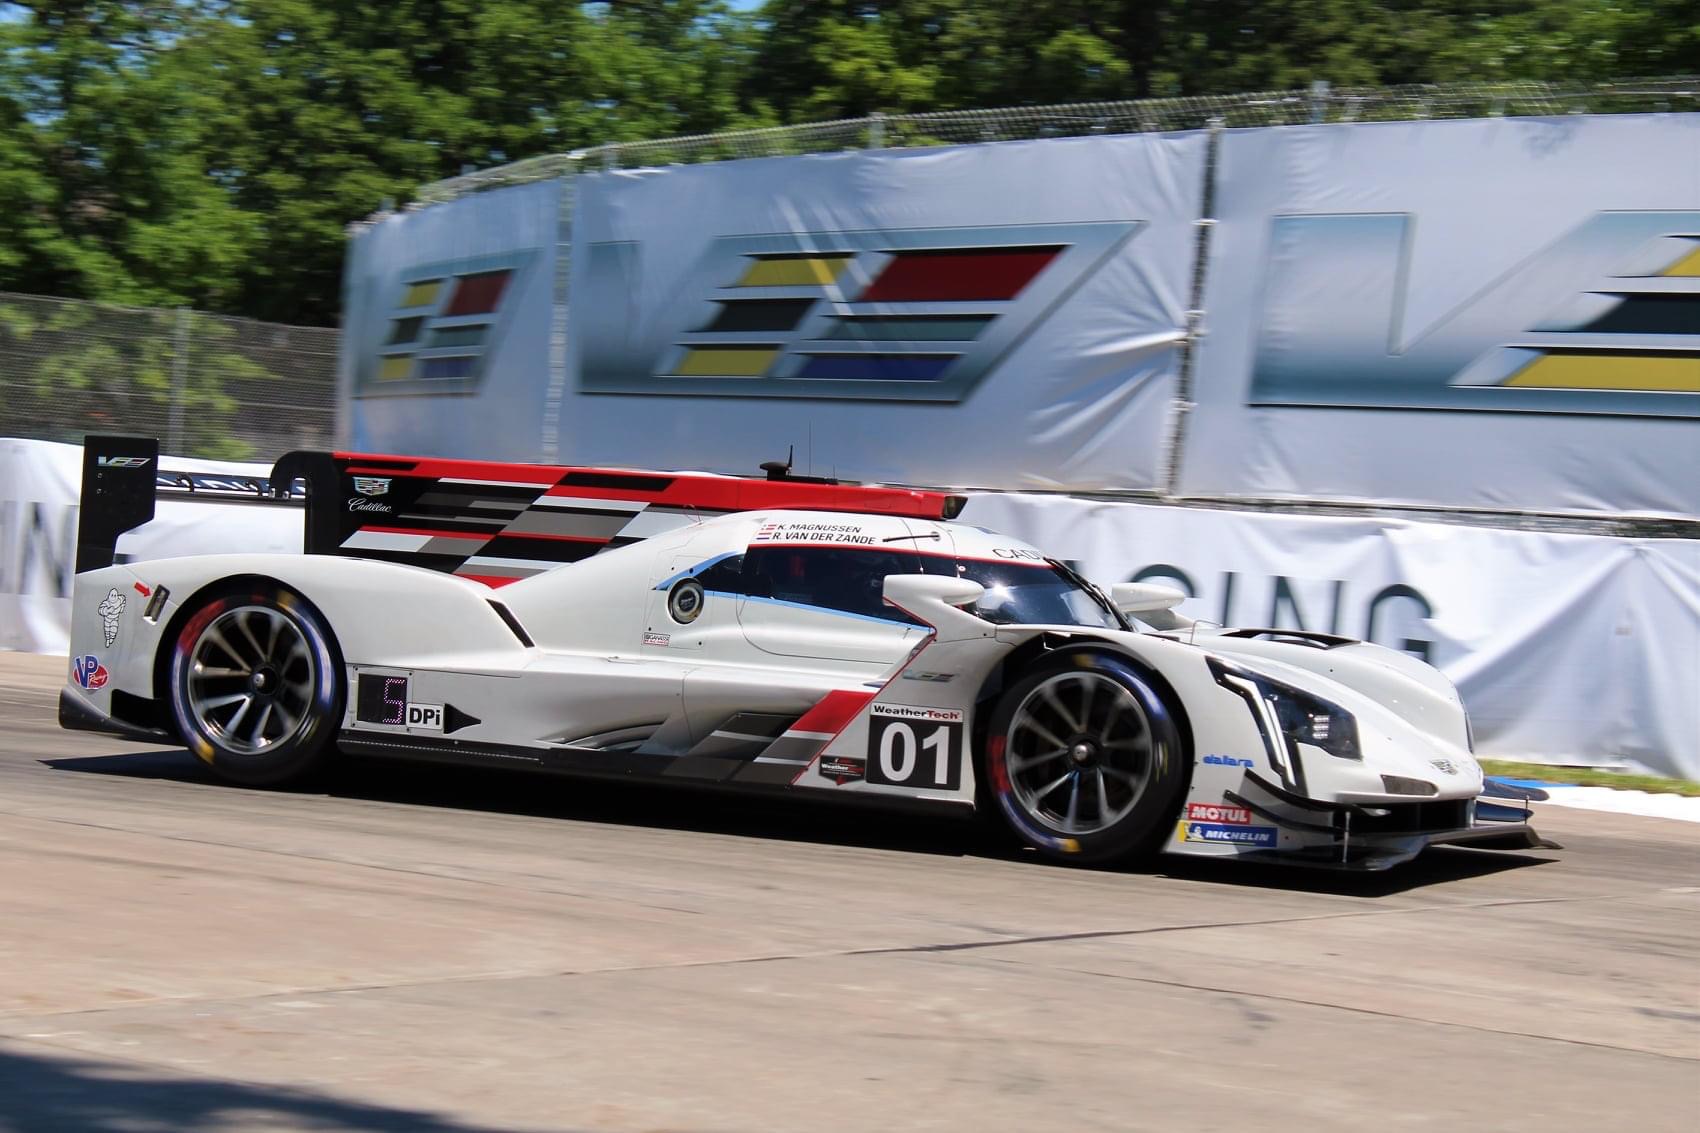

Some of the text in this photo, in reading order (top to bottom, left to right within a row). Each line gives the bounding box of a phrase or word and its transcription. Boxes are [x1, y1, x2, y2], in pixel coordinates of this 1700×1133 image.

[348, 498, 391, 512] Cadillac
[789, 524, 862, 534] MAGNUSSEN
[785, 532, 809, 540] VAN
[810, 532, 833, 541] DER
[836, 533, 876, 545] ZANDE
[74, 655, 99, 690] VP
[409, 707, 441, 726] DPi
[873, 704, 960, 720] WeatherTech
[879, 721, 950, 785] 01
[1203, 754, 1254, 768] dallara
[1191, 806, 1248, 822] MOTUL
[1205, 830, 1270, 841] MICHELIN
